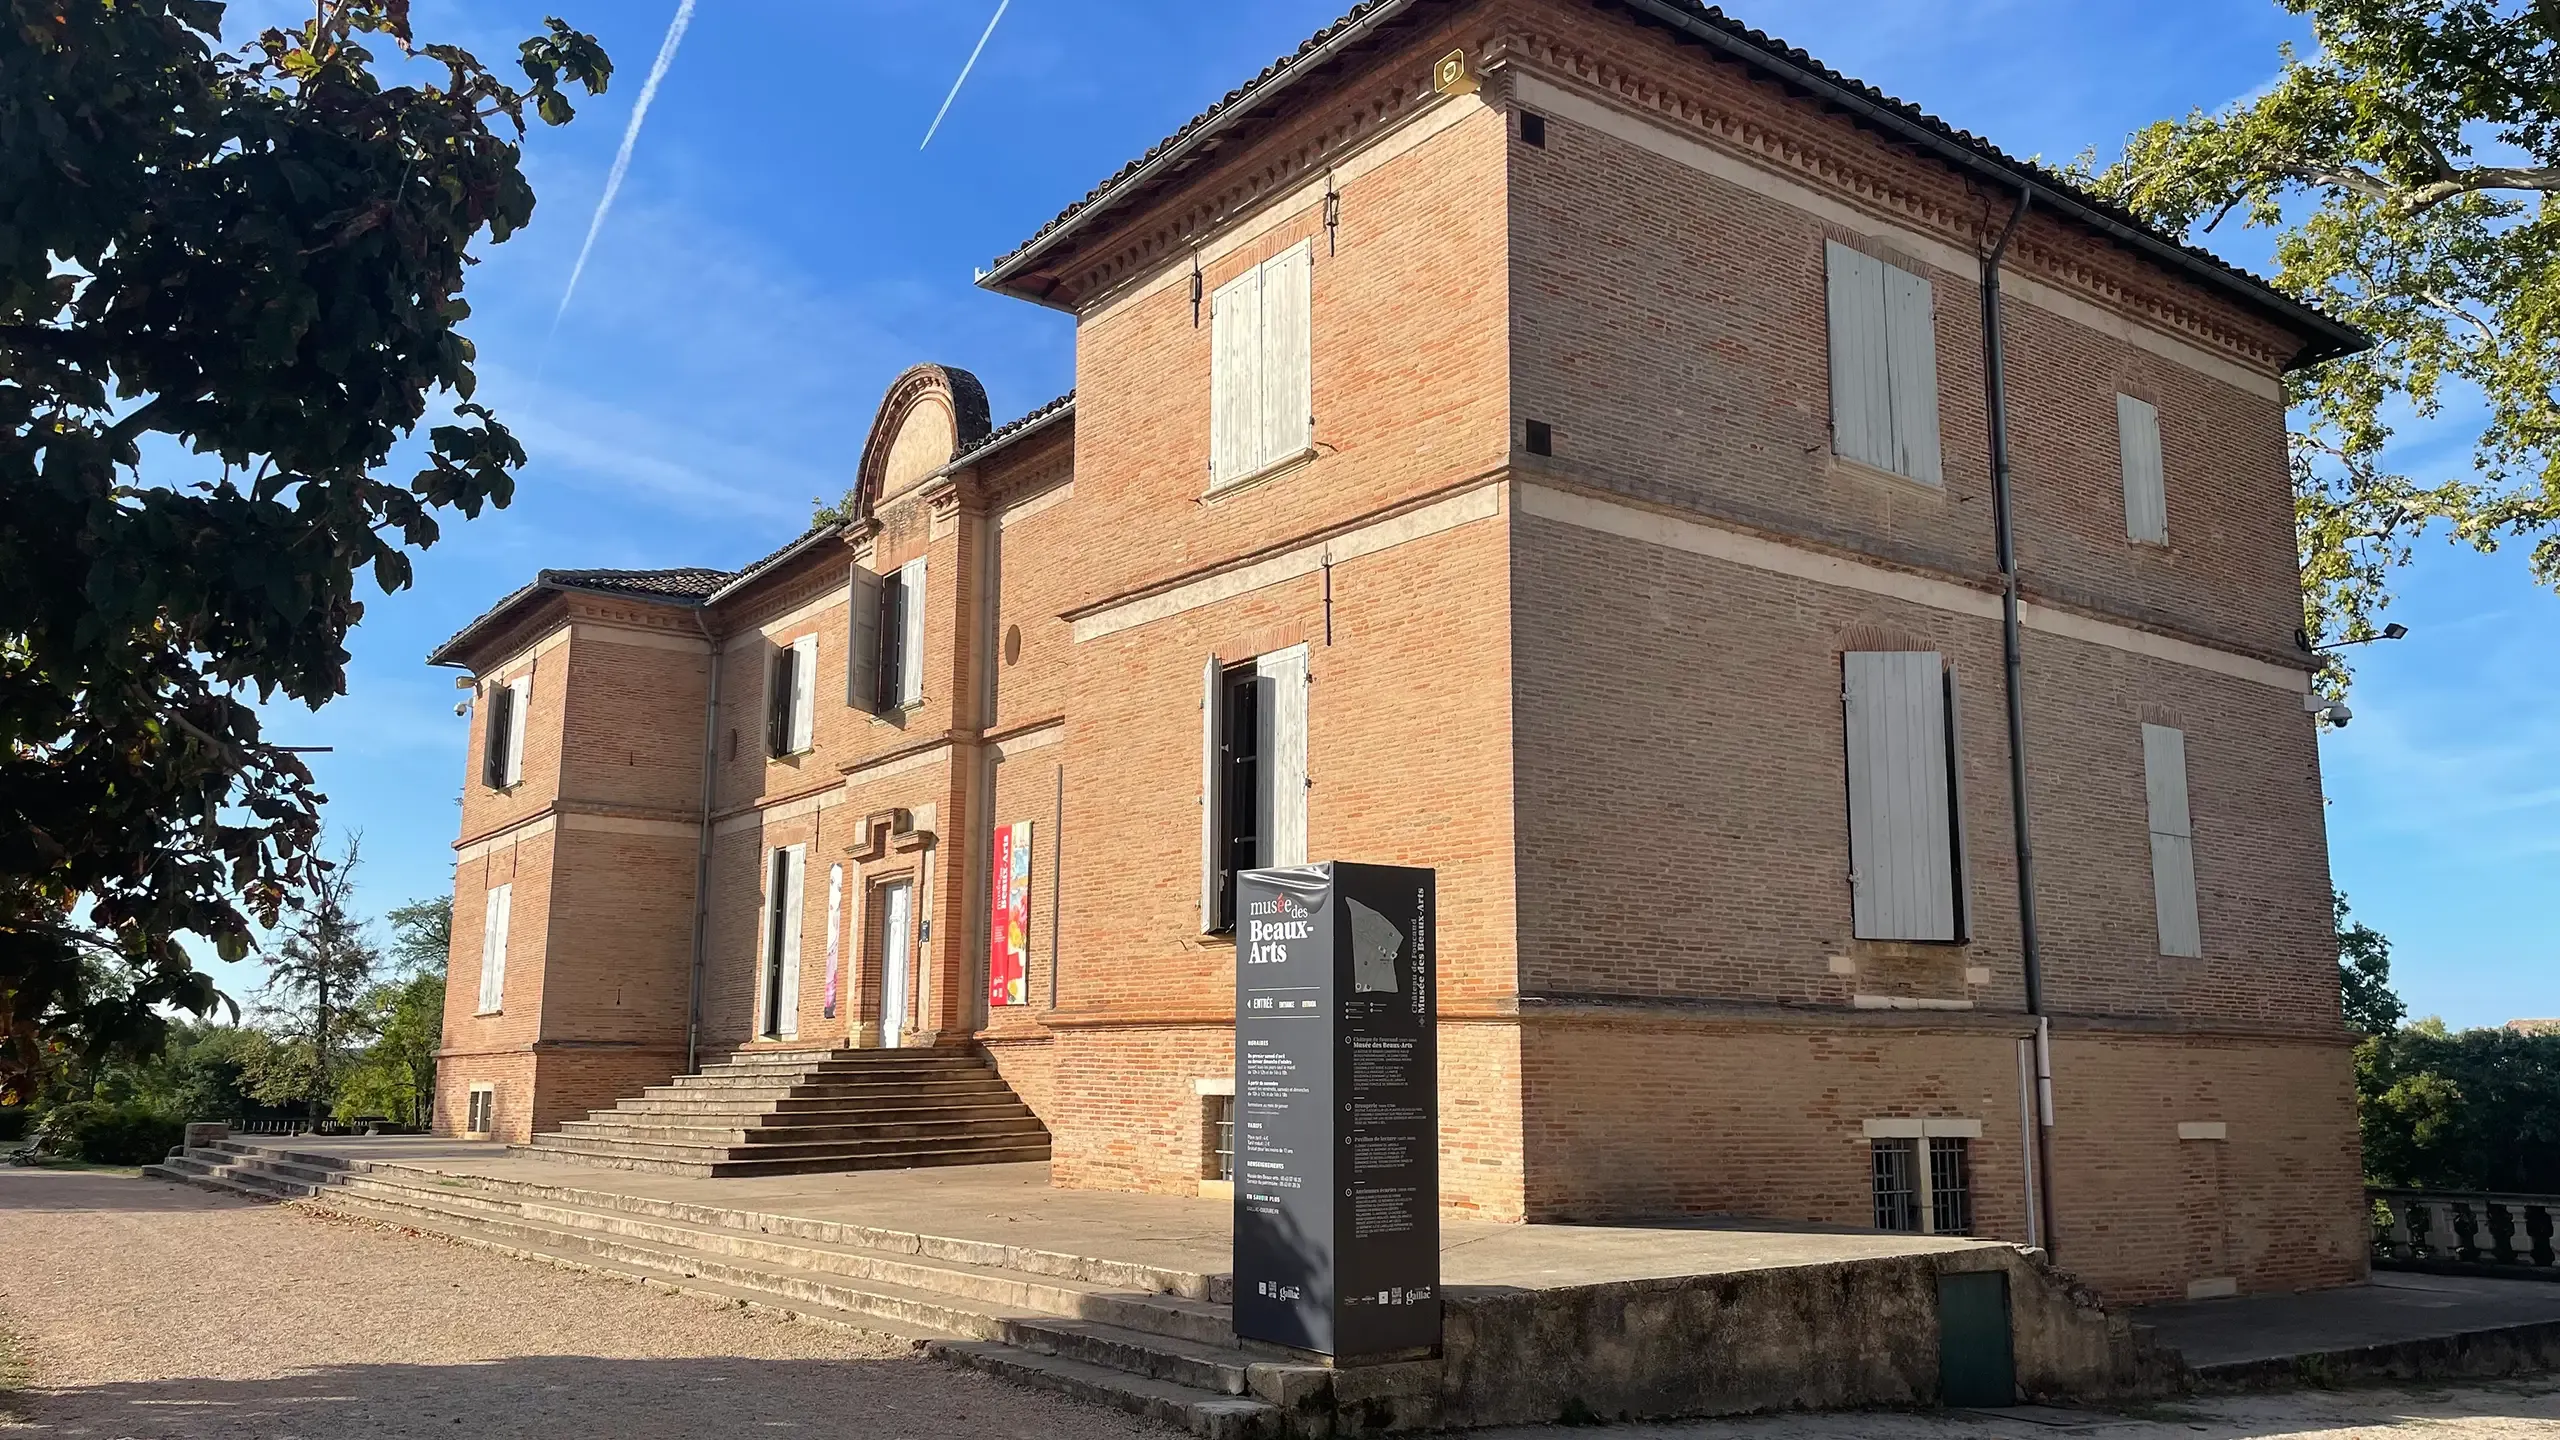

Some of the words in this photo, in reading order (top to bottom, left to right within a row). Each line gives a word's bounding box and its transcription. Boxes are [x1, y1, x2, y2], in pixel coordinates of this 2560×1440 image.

[1250, 893, 1292, 916] musée
[1292, 905, 1308, 919] des
[1249, 919, 1314, 942] Beaux-
[1417, 887, 1425, 951] Beaux-Arts
[1248, 942, 1288, 965] Arts
[1411, 961, 1417, 972] de
[1254, 996, 1274, 1009] ENTRÉE
[1417, 976, 1425, 1013] Musée
[1406, 1289, 1432, 1306] gaillac
